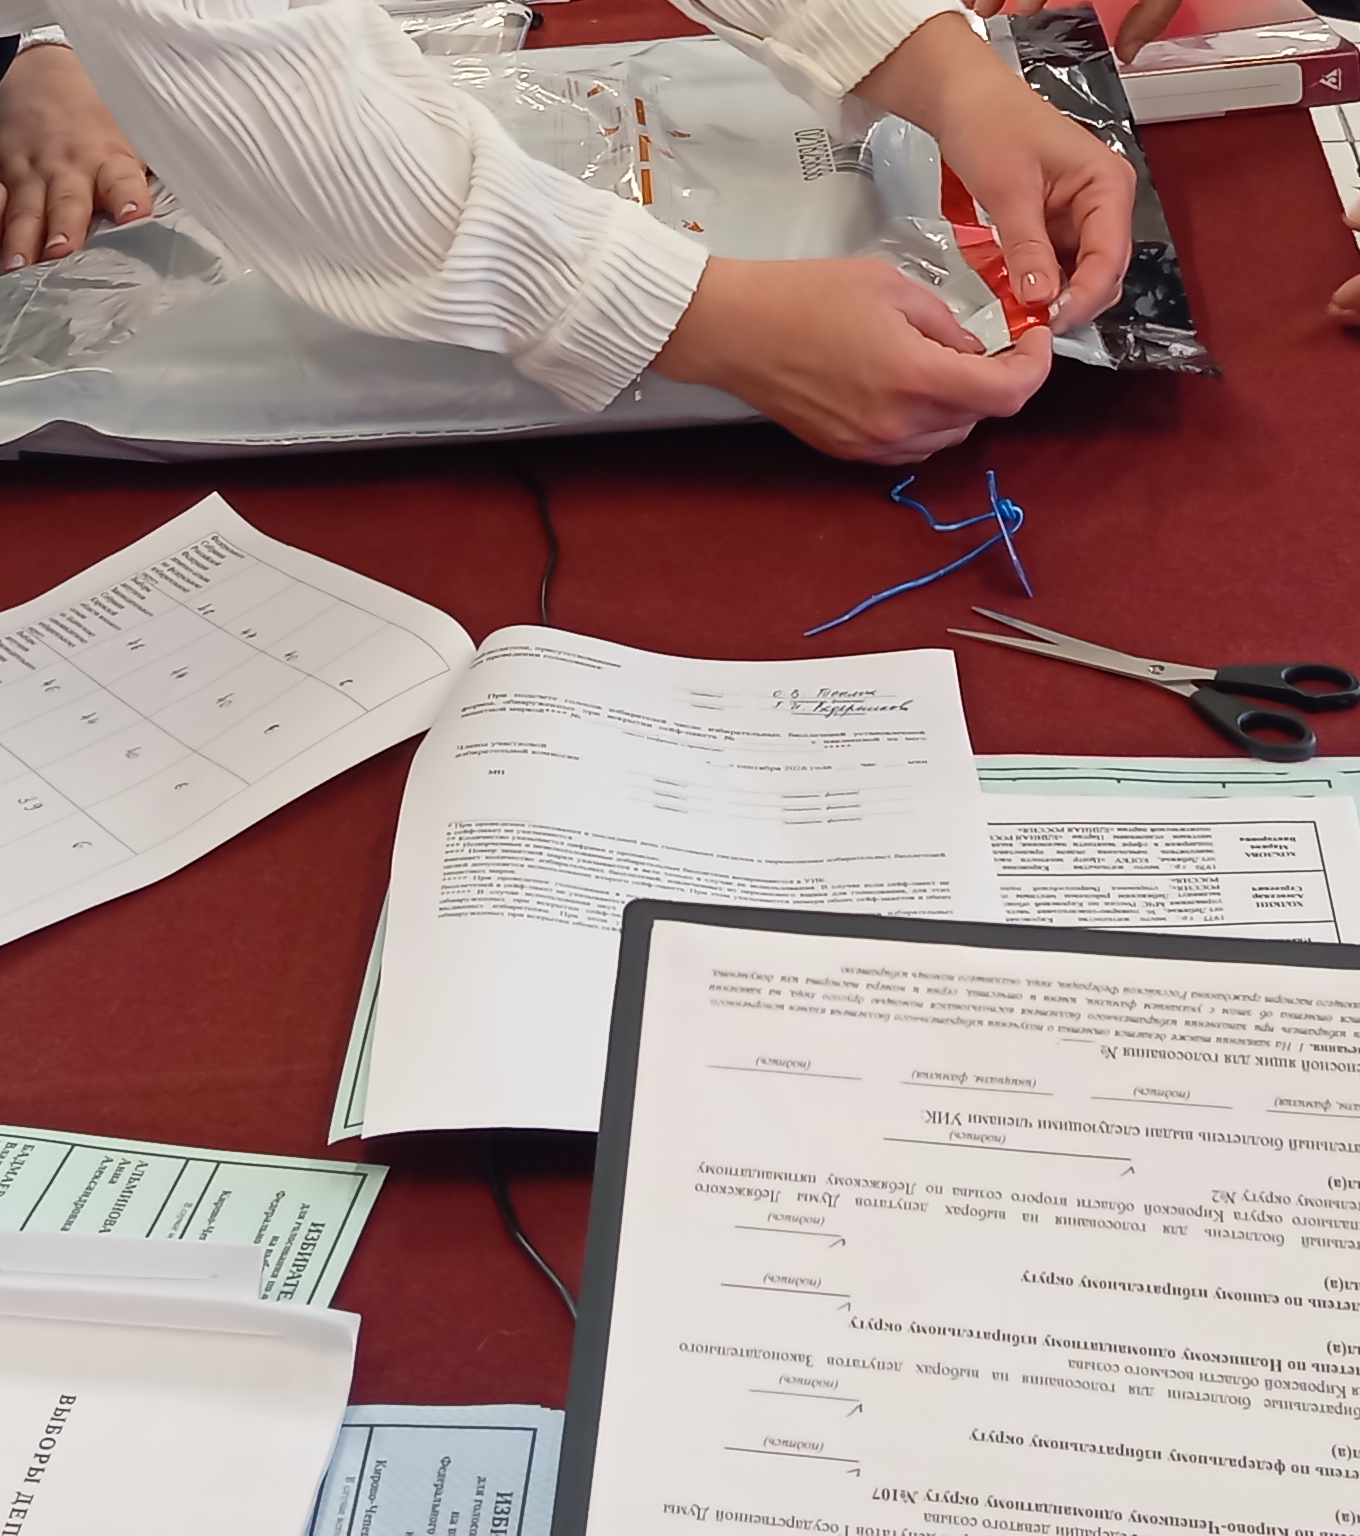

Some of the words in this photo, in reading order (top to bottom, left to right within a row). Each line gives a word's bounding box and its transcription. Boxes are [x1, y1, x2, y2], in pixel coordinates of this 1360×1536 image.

[1121, 1046, 1219, 1063] голосования
[1222, 1052, 1248, 1065] для
[1253, 1054, 1297, 1069] ящик
[966, 1112, 1033, 1129] членами
[1036, 1118, 1141, 1136] следующими
[1144, 1125, 1194, 1141] выдан
[1197, 1130, 1284, 1151] бюллетень
[106, 1156, 132, 1185] Анна
[59, 1154, 115, 1232] Александровна
[97, 1158, 149, 1234] АЛЬМИНОВА
[693, 1182, 782, 1203] Лебяжского
[795, 1190, 841, 1208] Думы
[1241, 1188, 1292, 1205] округу
[853, 1196, 925, 1212] депутатов
[943, 1202, 1006, 1222] выборах
[1020, 1211, 1039, 1223] на
[1053, 1214, 1147, 1232] голосования
[1161, 1223, 1188, 1236] для
[1203, 1227, 1285, 1247] бюллетень
[761, 1272, 822, 1289] (подпись)
[847, 1315, 903, 1332] округу
[908, 1323, 1037, 1347] избирательному
[677, 1341, 813, 1368] Законодательного
[1043, 1335, 1176, 1359] одномандатному
[825, 1355, 903, 1372] депутатов
[1066, 1358, 1120, 1373] созыва
[1182, 1349, 1282, 1373] Нолинскому
[1286, 1359, 1307, 1371] по
[914, 1362, 980, 1380] выборах
[990, 1370, 1009, 1382] на
[1122, 1364, 1194, 1381] восьмого
[1021, 1373, 1115, 1393] голосования
[1198, 1371, 1260, 1390] области
[1263, 1377, 1347, 1400] Кировской
[1127, 1383, 1155, 1397] для
[1166, 1387, 1252, 1410] бюллетени
[23, 1393, 77, 1484] ВЫБОРЫ
[761, 1435, 825, 1453] (подпись)
[968, 1427, 1025, 1446] округу
[1028, 1436, 1162, 1463] избирательному
[1168, 1450, 1286, 1476] федеральному
[1289, 1463, 1310, 1475] по
[871, 1487, 916, 1504] №107
[922, 1488, 979, 1506] округу
[662, 1502, 710, 1521] Думы
[985, 1496, 1123, 1521] одномандатному
[714, 1508, 849, 1536] Государственной
[922, 1511, 978, 1527] созыва
[980, 1517, 1051, 1535] девятого
[1129, 1512, 1289, 1536] Кирово-Чепецкому
